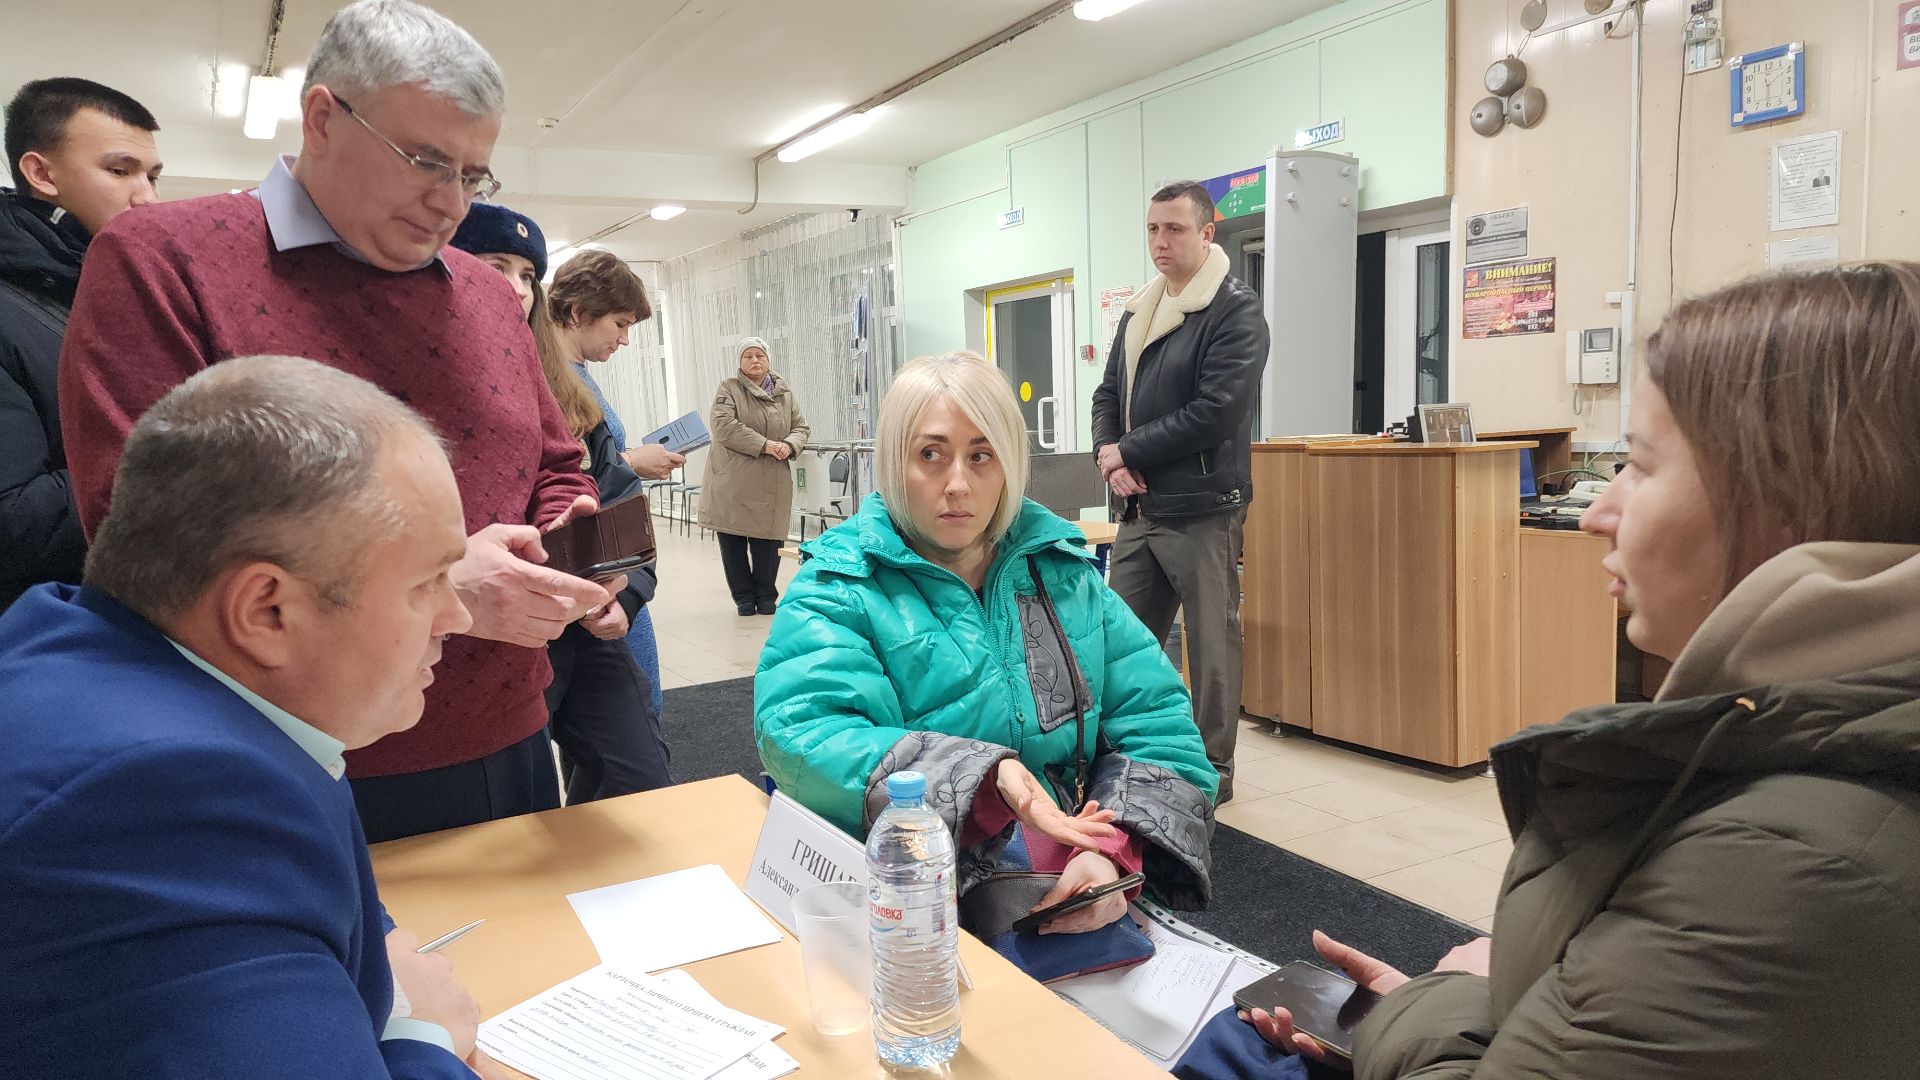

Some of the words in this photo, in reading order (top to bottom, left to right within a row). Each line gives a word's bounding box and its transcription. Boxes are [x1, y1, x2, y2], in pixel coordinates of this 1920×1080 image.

[1765, 61, 1774, 71] 12
[1778, 60, 1782, 68] 1
[1753, 64, 1761, 73] 11
[1786, 65, 1791, 73] 2
[1745, 75, 1754, 83] 10
[1786, 76, 1791, 84] 3
[1746, 85, 1751, 93] 9
[1786, 88, 1791, 96] 4
[1746, 97, 1751, 105] 8
[1766, 100, 1771, 108] 6
[1777, 97, 1783, 106] 5
[1754, 102, 1760, 111] 7
[1485, 262, 1553, 280] ВНИМАНИЕ!
